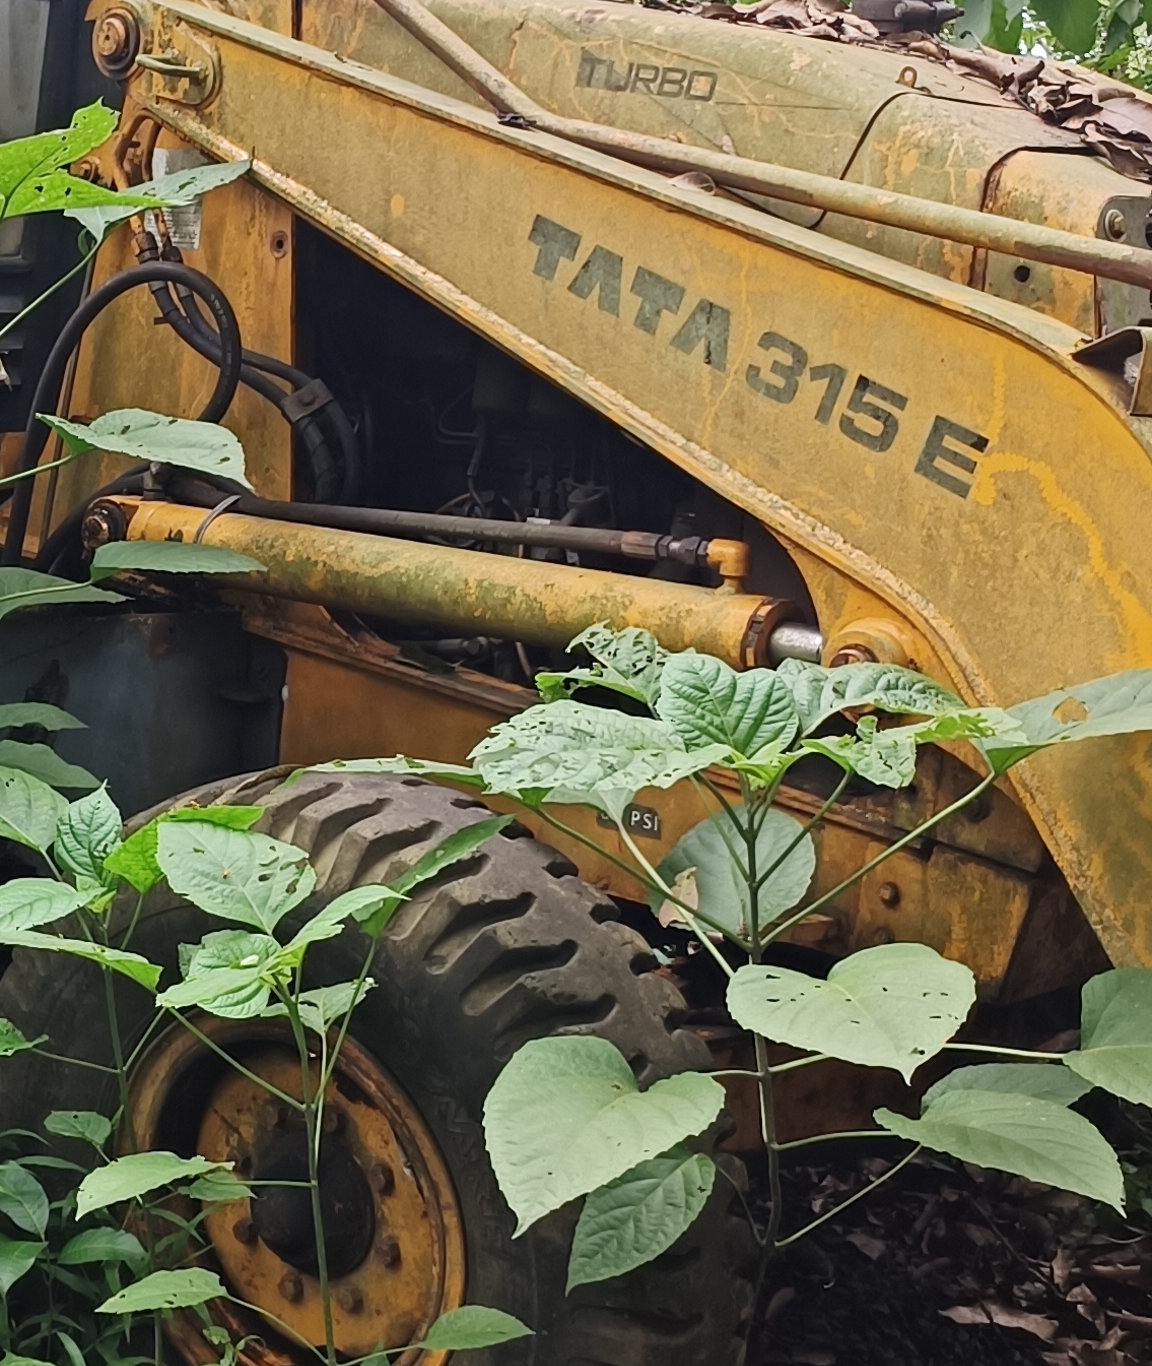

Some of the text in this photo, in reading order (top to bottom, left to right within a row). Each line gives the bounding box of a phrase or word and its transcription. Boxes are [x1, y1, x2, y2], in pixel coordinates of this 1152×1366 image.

[578, 49, 718, 103] TURBO
[528, 213, 989, 499] TATA 315 E
[630, 810, 658, 831] PSI
